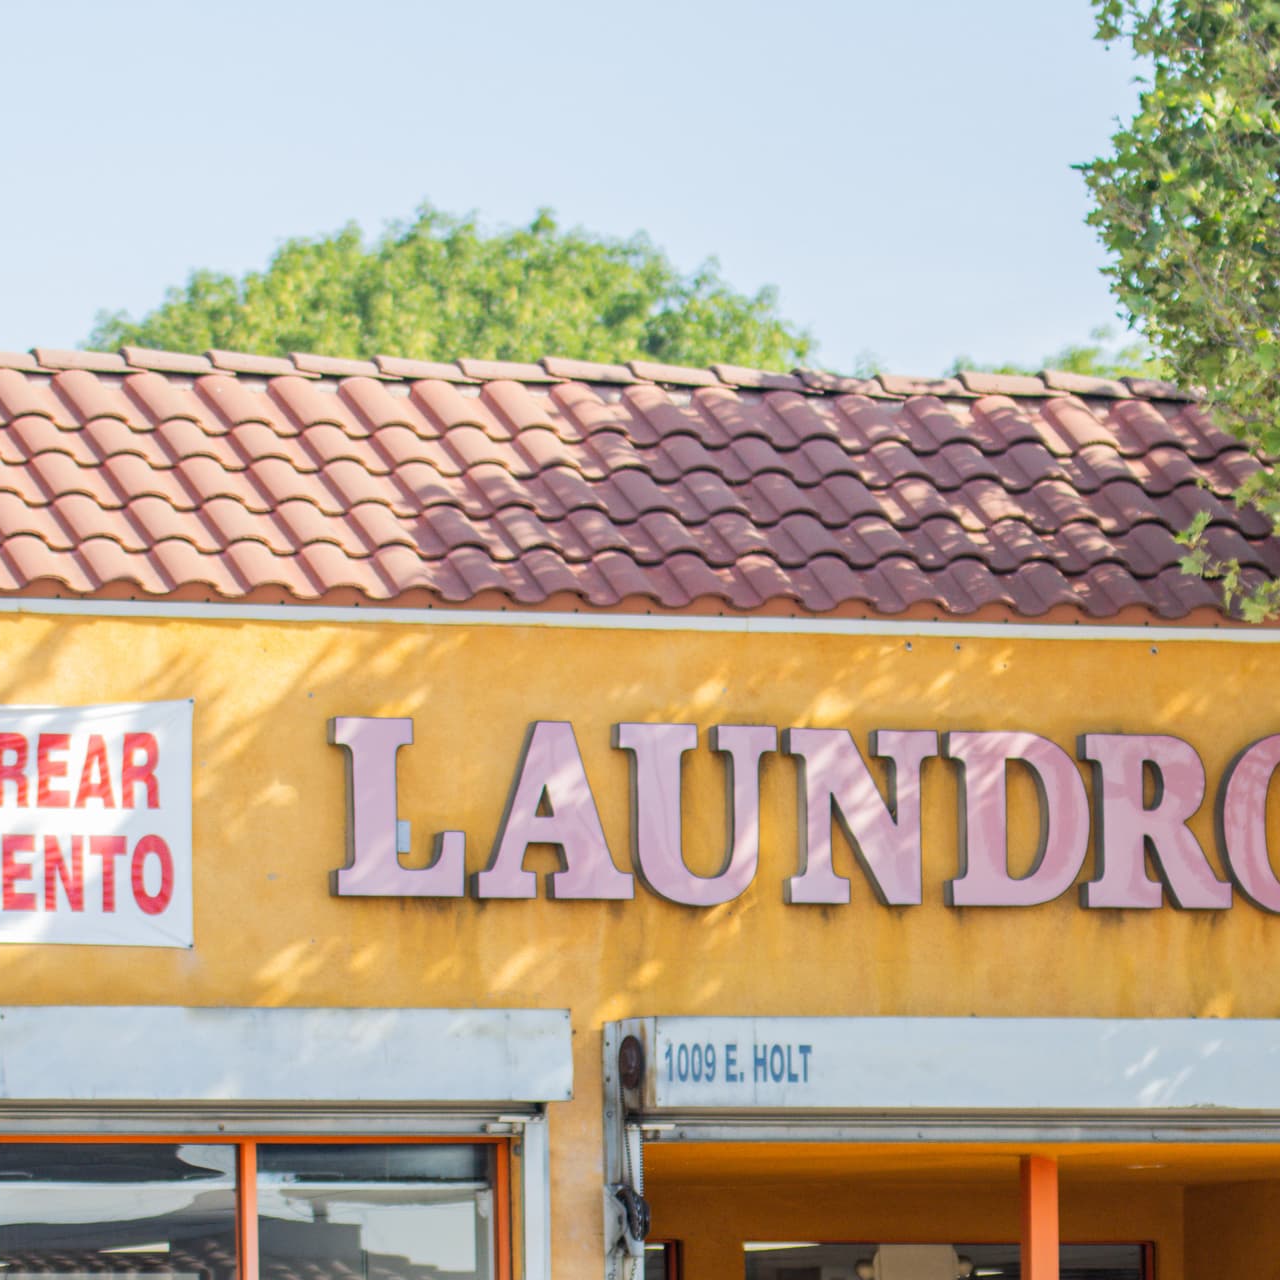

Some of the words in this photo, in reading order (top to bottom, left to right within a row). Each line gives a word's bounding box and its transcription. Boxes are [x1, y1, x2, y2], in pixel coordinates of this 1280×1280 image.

[664, 1042, 717, 1083] 1009
[724, 1043, 745, 1083] E.
[753, 1043, 813, 1083] HOLT
